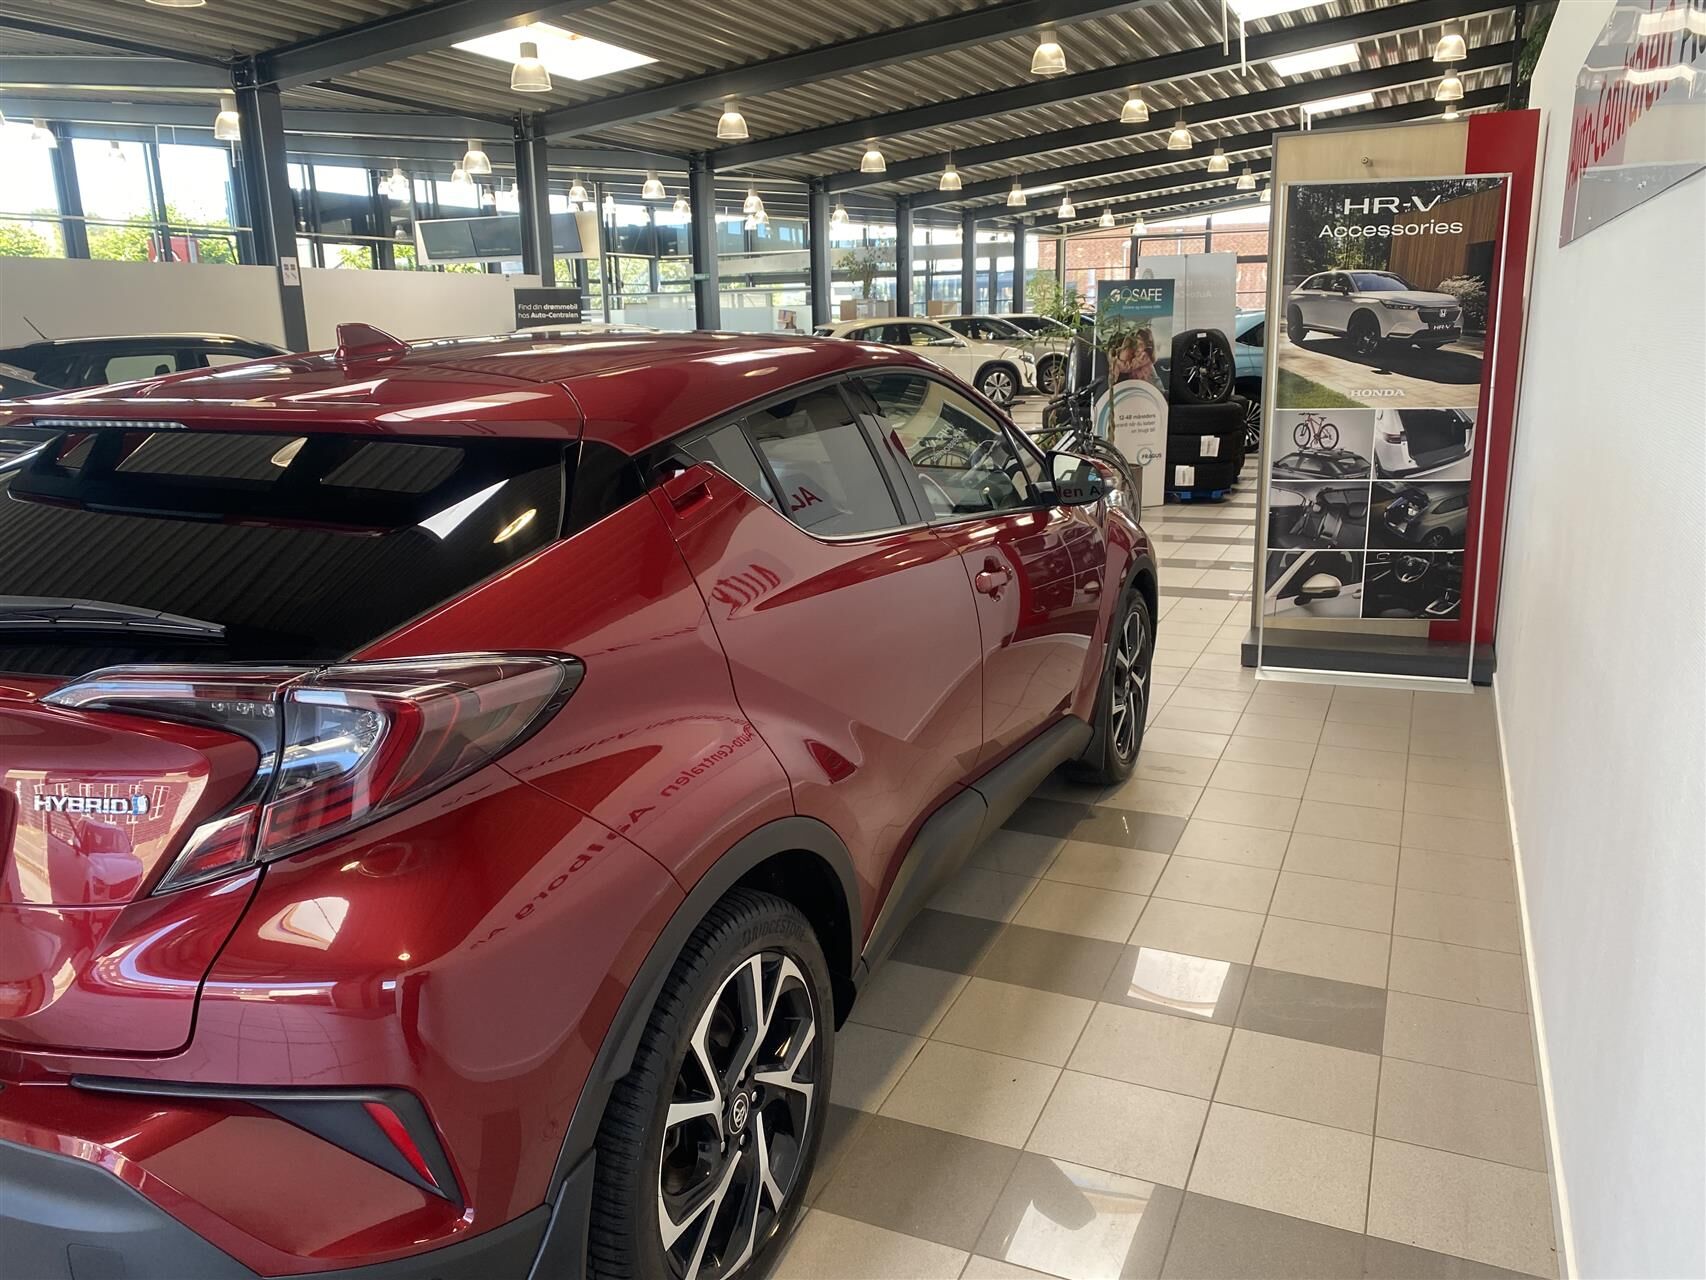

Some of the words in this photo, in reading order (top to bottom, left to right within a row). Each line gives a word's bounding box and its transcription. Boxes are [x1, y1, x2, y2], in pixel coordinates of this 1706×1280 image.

[1344, 195, 1441, 215] HR-V
[1318, 219, 1463, 238] Accessories
[1350, 389, 1405, 397] HONDA
[33, 795, 128, 814] HYBRID
